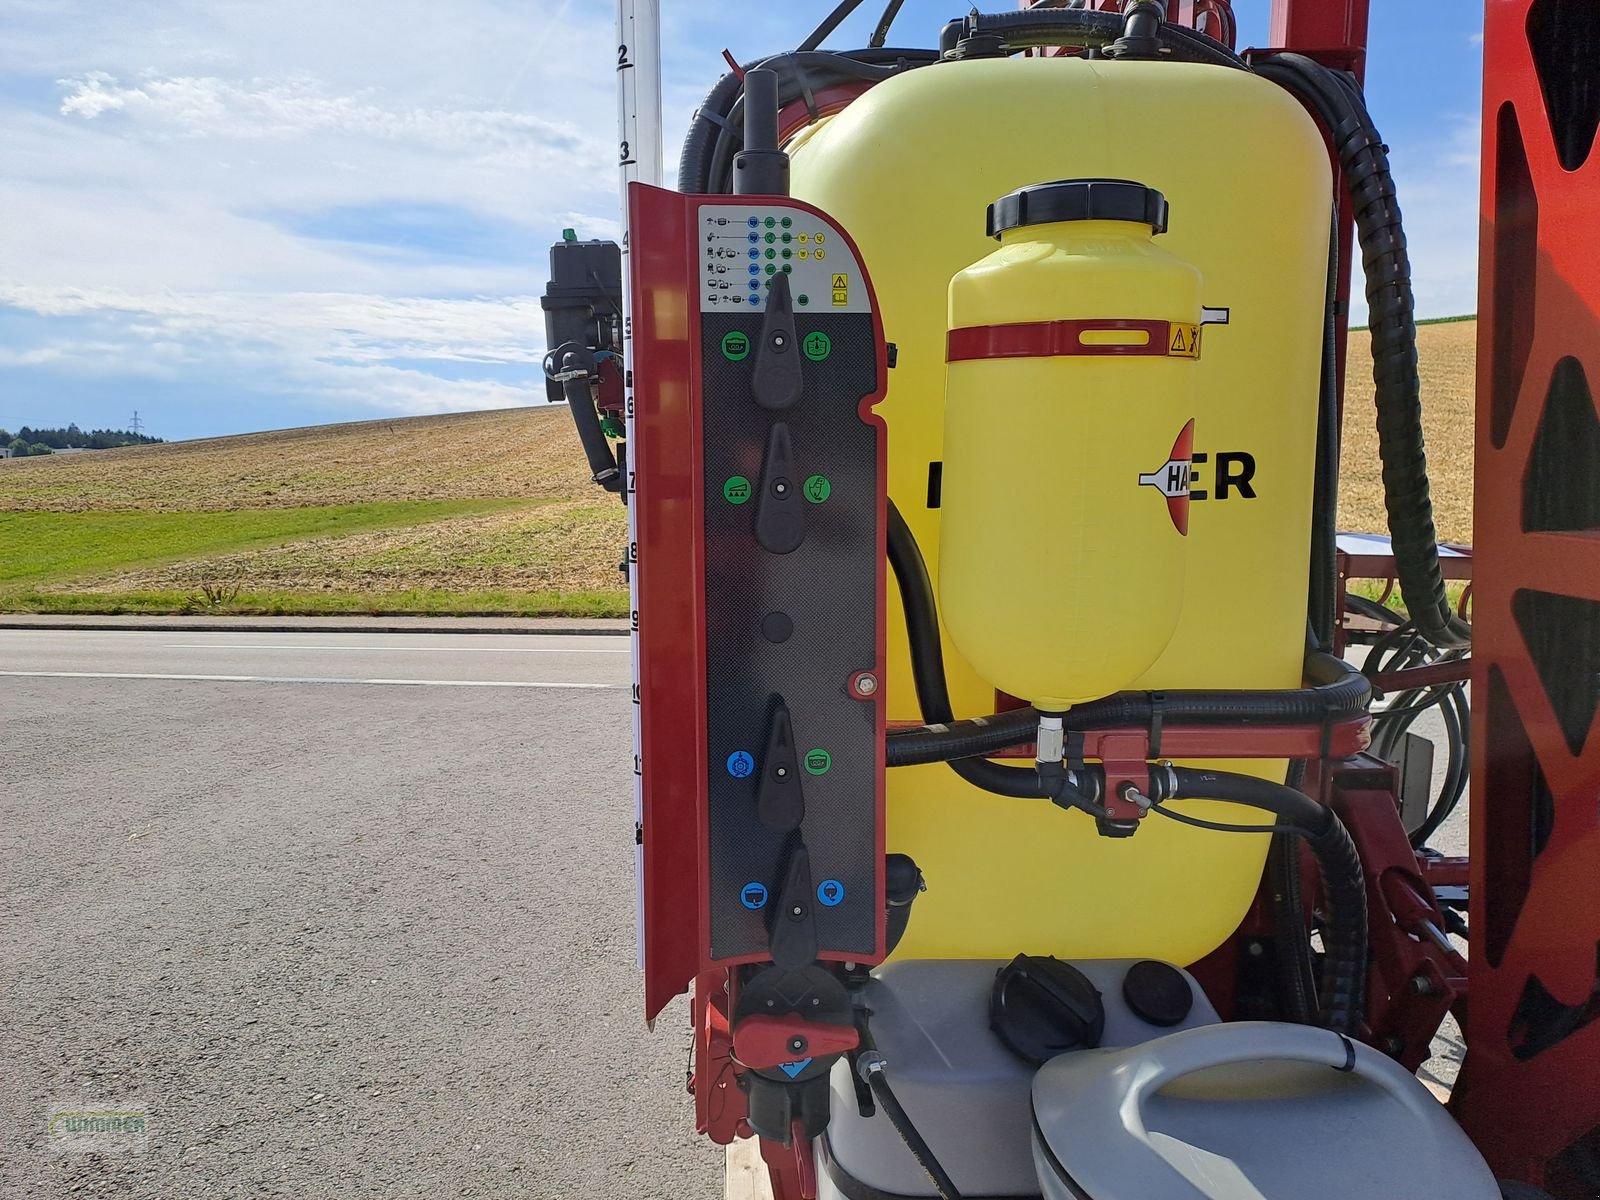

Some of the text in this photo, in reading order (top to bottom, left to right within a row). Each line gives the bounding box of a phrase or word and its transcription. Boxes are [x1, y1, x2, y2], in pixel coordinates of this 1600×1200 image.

[617, 44, 628, 65] 2
[620, 141, 630, 160] 3
[622, 230, 629, 248] 4
[625, 317, 631, 334] 5
[626, 396, 634, 414] 6
[629, 472, 636, 489] 7
[630, 542, 637, 559] 8
[632, 610, 639, 627] 9
